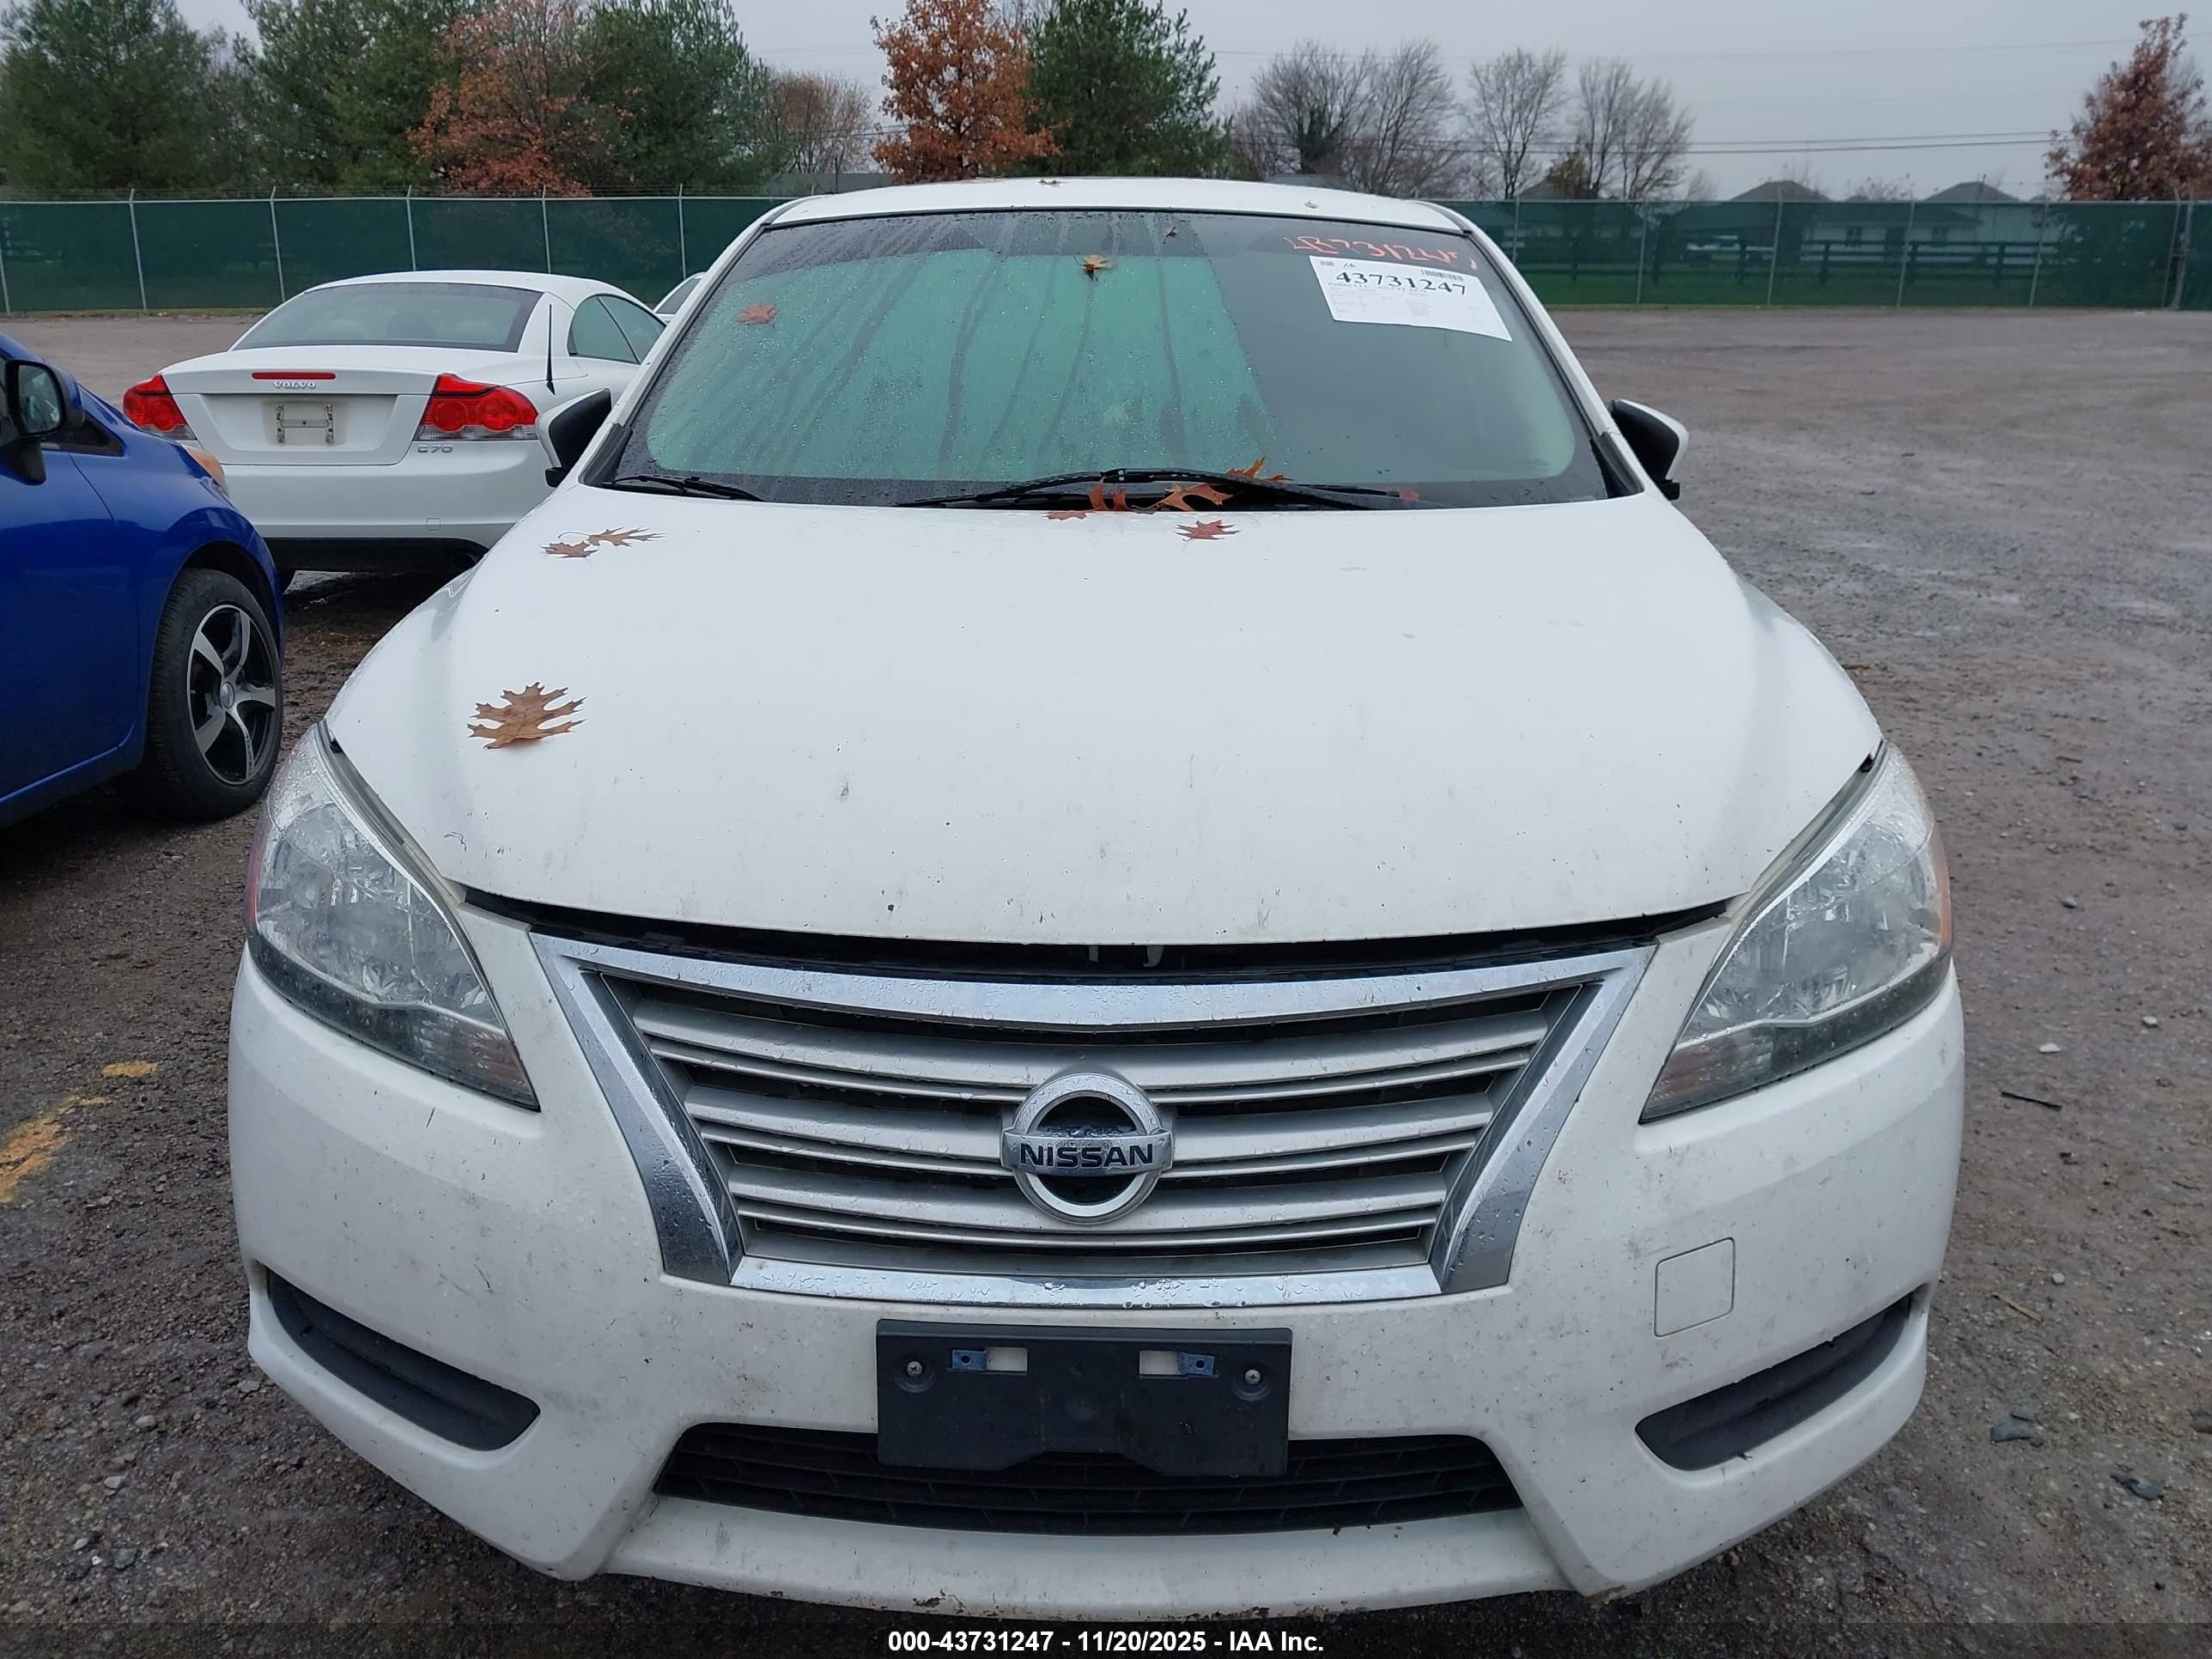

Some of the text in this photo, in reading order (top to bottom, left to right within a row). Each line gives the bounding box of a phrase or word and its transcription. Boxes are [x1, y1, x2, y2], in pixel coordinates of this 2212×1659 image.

[1336, 271, 1466, 295] 43731247
[417, 444, 453, 453] C70
[1020, 1143, 1153, 1168] NISSAN
